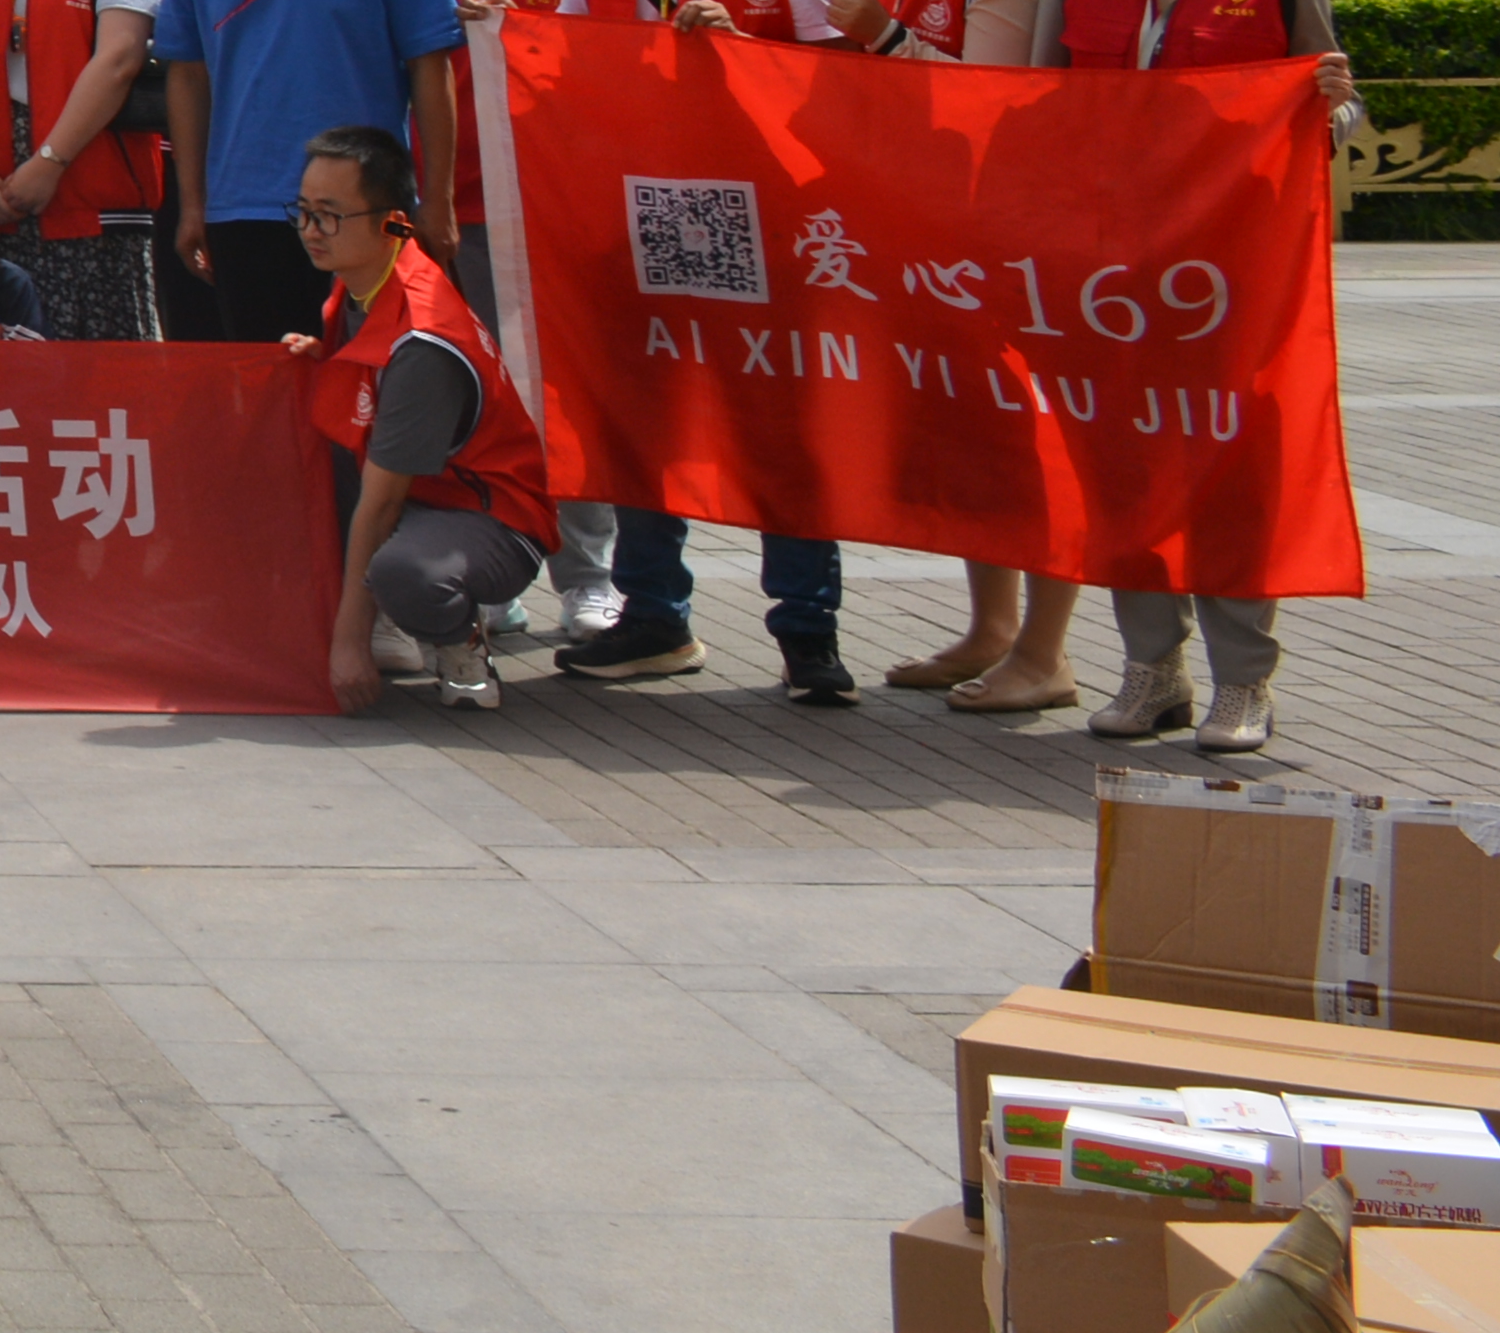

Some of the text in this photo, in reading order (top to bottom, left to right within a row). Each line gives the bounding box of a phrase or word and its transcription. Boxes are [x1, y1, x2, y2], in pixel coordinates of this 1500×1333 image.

[793, 208, 1230, 342] 爱心169
[646, 316, 1240, 442] AI XIN YI LIU JIU
